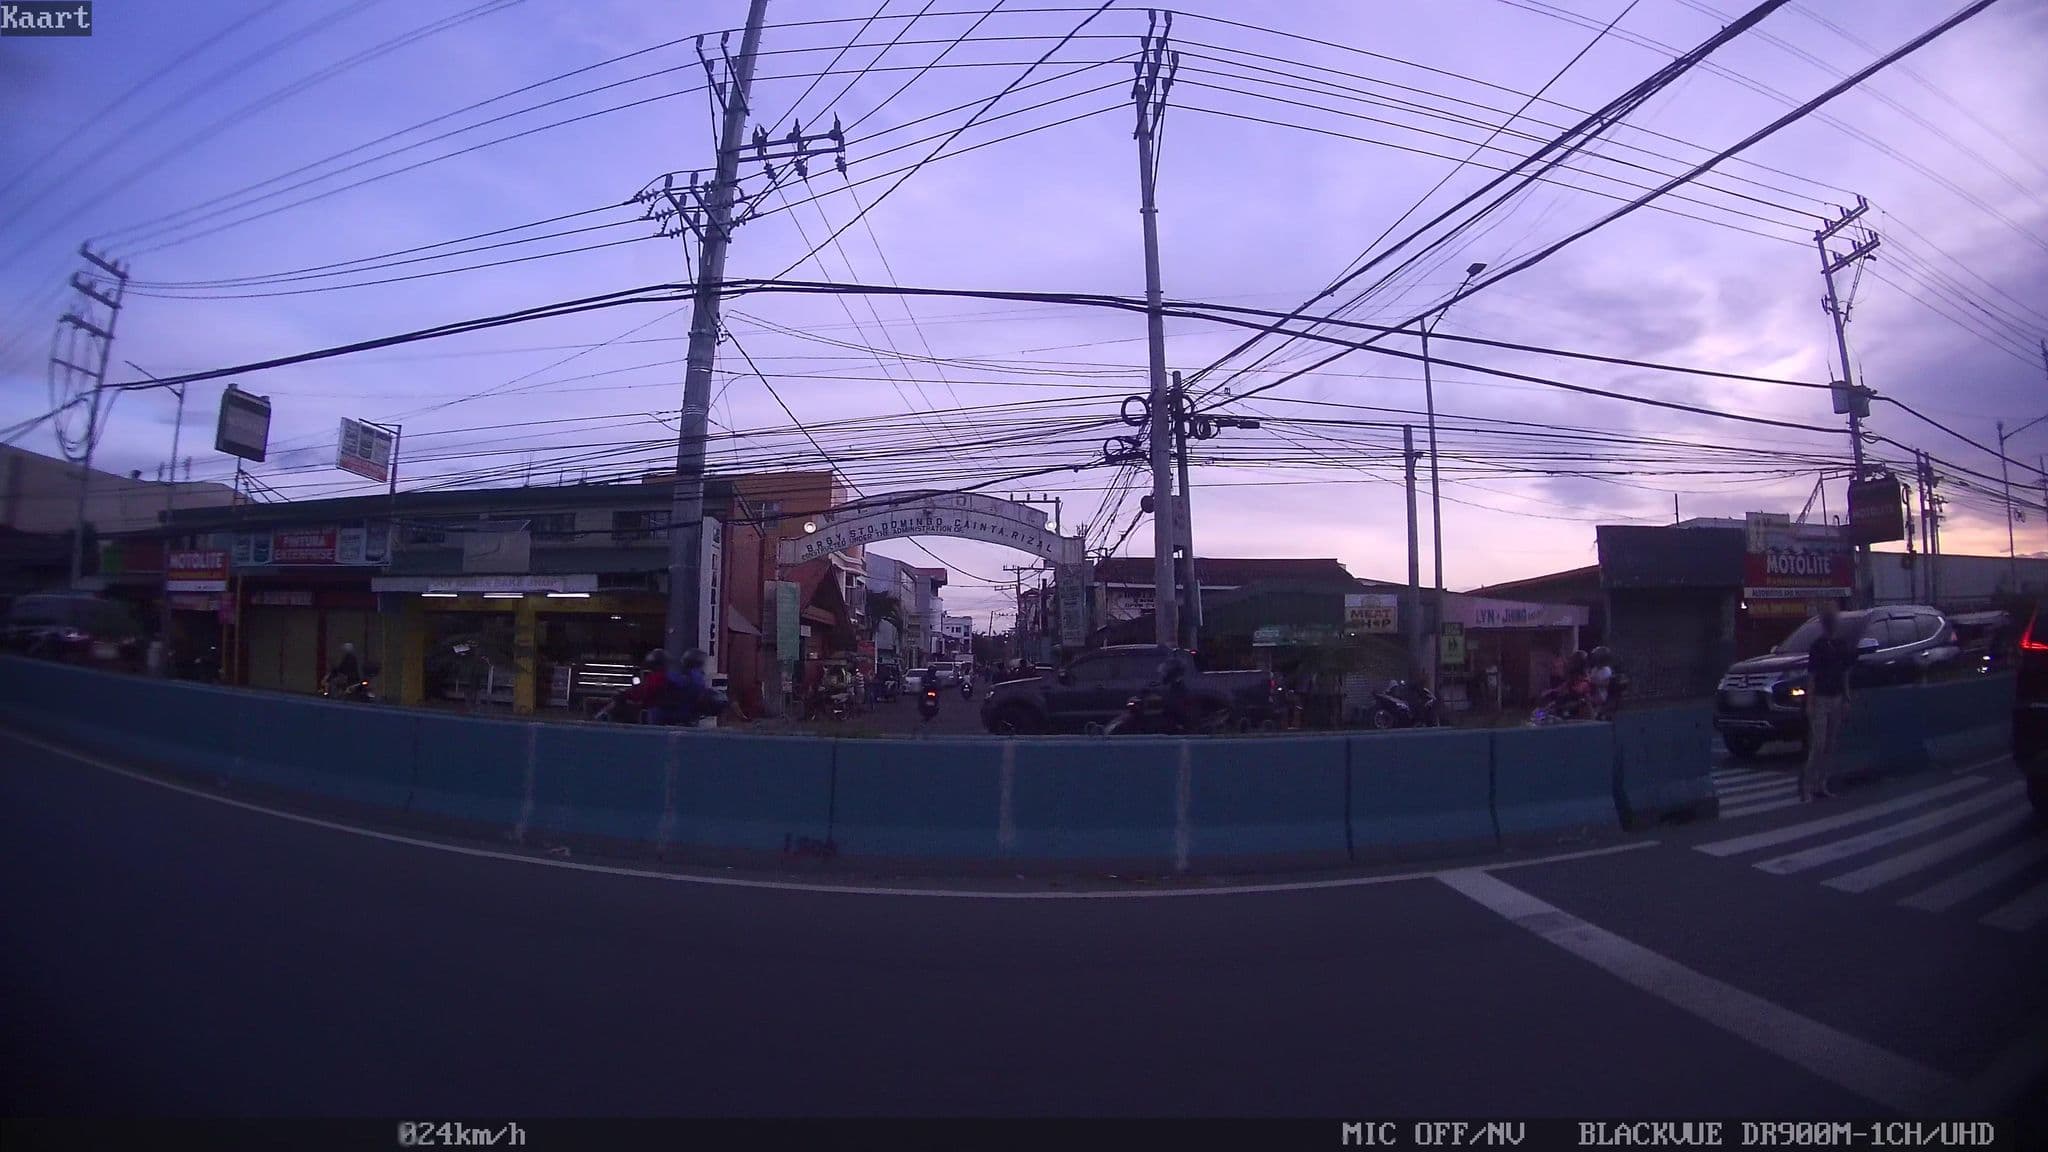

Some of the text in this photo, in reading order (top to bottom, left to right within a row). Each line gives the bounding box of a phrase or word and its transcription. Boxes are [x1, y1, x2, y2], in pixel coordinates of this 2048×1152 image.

[882, 517, 943, 530] DOMINGO
[1011, 531, 1052, 552] RIZAL
[169, 552, 225, 568] MOTOLITE
[1766, 554, 1832, 575] MOTOLITE
[1351, 609, 1392, 618] MEAT
[1475, 607, 1495, 625] LYN
